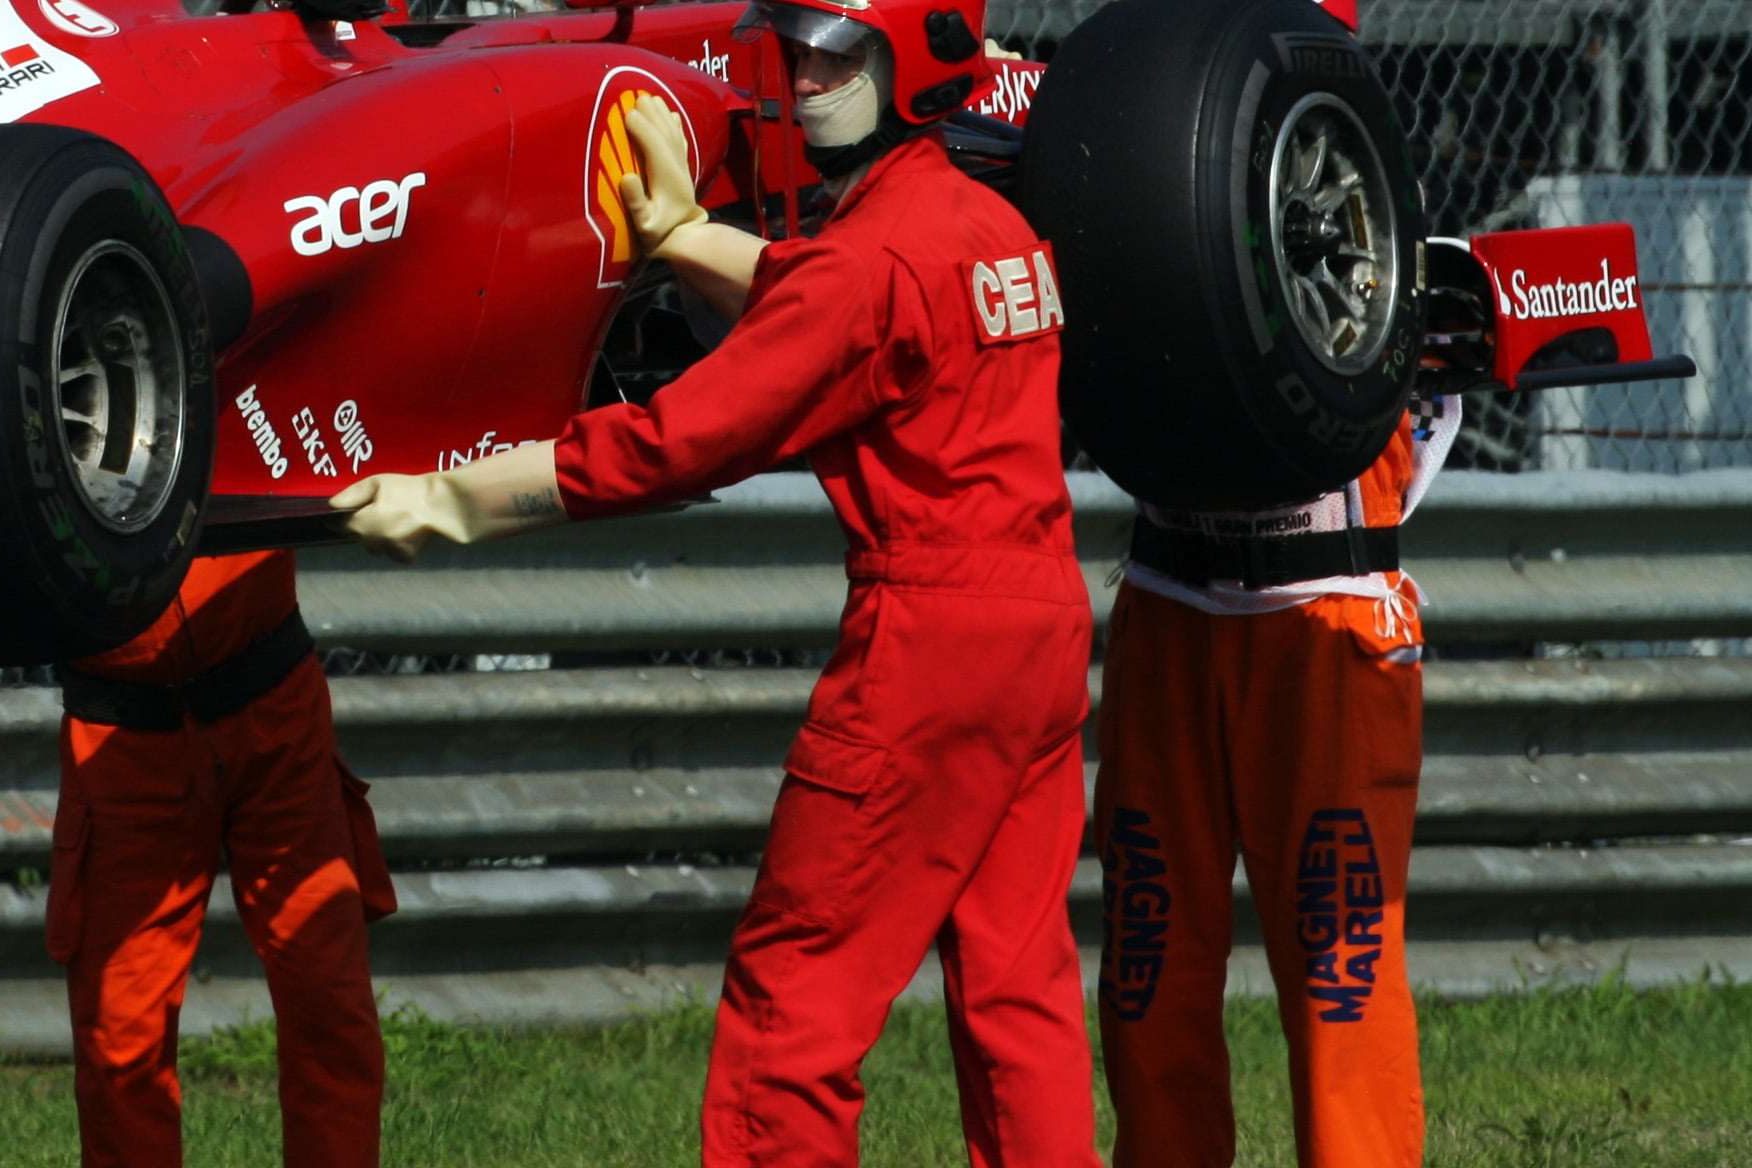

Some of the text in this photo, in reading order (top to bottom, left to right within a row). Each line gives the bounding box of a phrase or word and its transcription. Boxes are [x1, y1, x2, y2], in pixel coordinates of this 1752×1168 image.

[283, 172, 427, 257] acer
[972, 251, 1065, 337] CEA
[1511, 257, 1639, 321] Santander
[235, 384, 289, 480] brembo
[291, 406, 338, 478] SKF
[1254, 511, 1311, 533] PREMIO
[1111, 805, 1172, 1022] MAGNETI
[1296, 809, 1366, 1022] MAGNETI
[1316, 809, 1384, 1022] MARELLI
